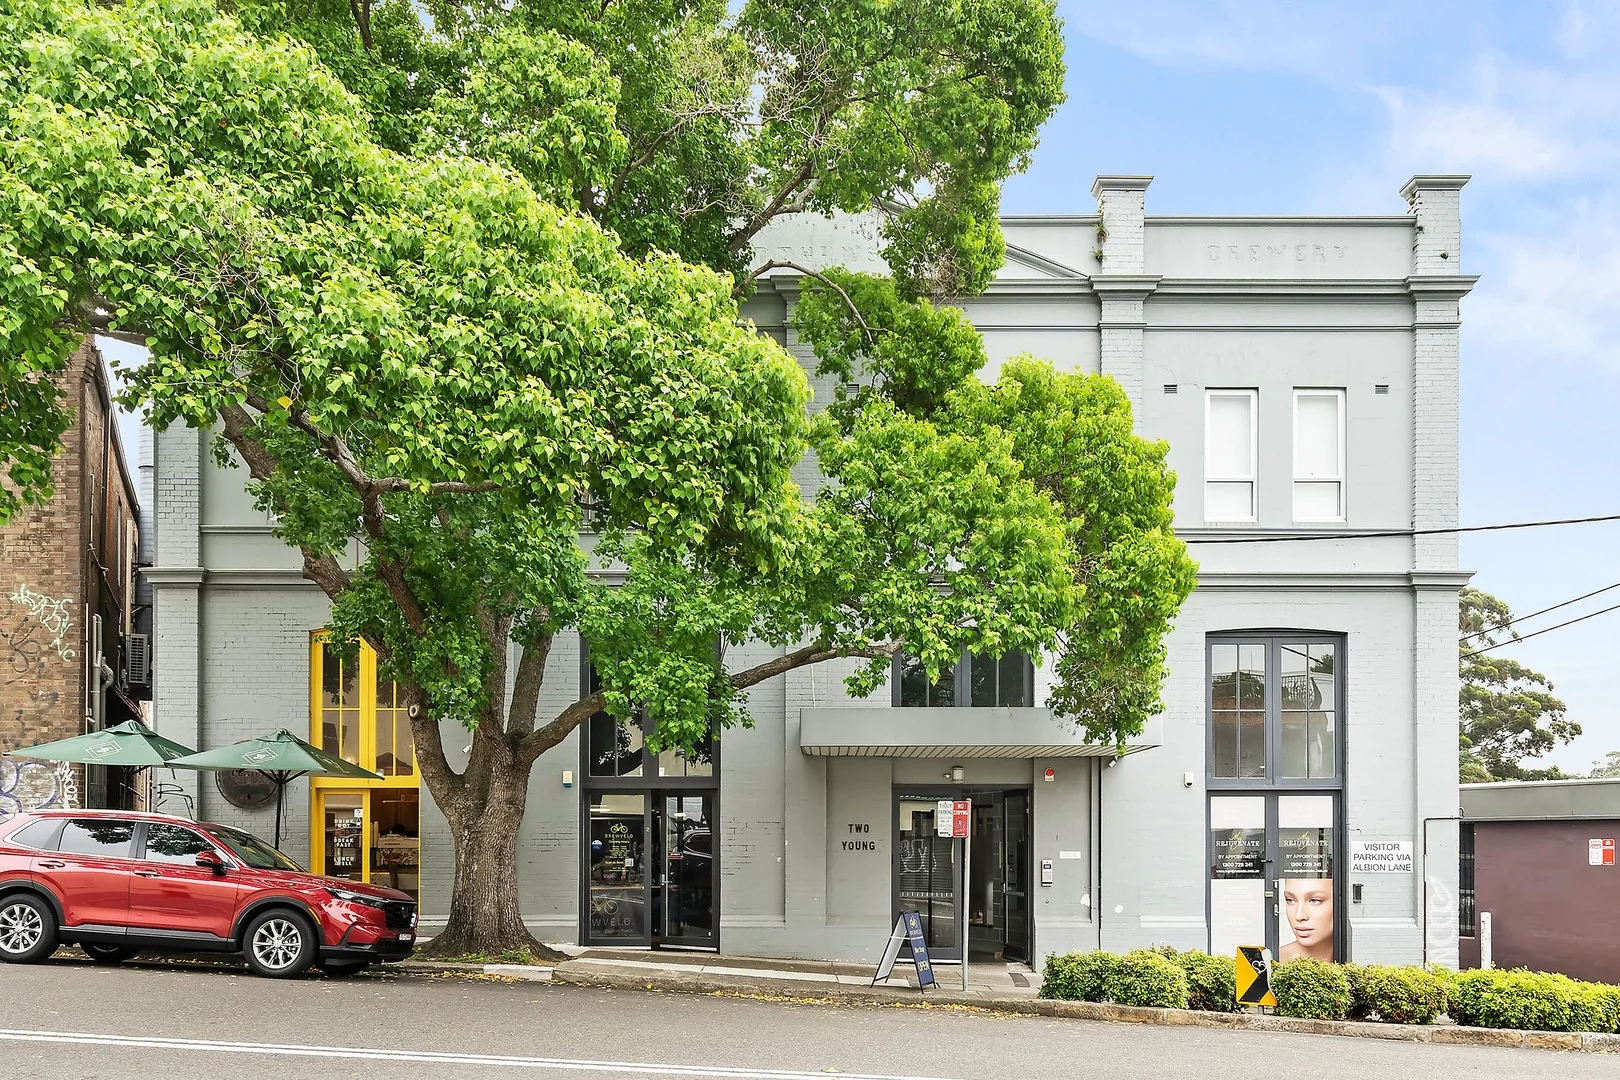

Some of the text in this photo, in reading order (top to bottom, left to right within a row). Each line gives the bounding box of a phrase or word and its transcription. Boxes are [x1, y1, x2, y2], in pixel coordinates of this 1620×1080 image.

[848, 823, 869, 834] TWO
[841, 841, 876, 851] YOUNG
[1363, 843, 1400, 851] VISITOR
[1353, 853, 1411, 861] PARKING VIA
[1352, 863, 1411, 871] ALBION LANE
[592, 917, 631, 927] WVELO
